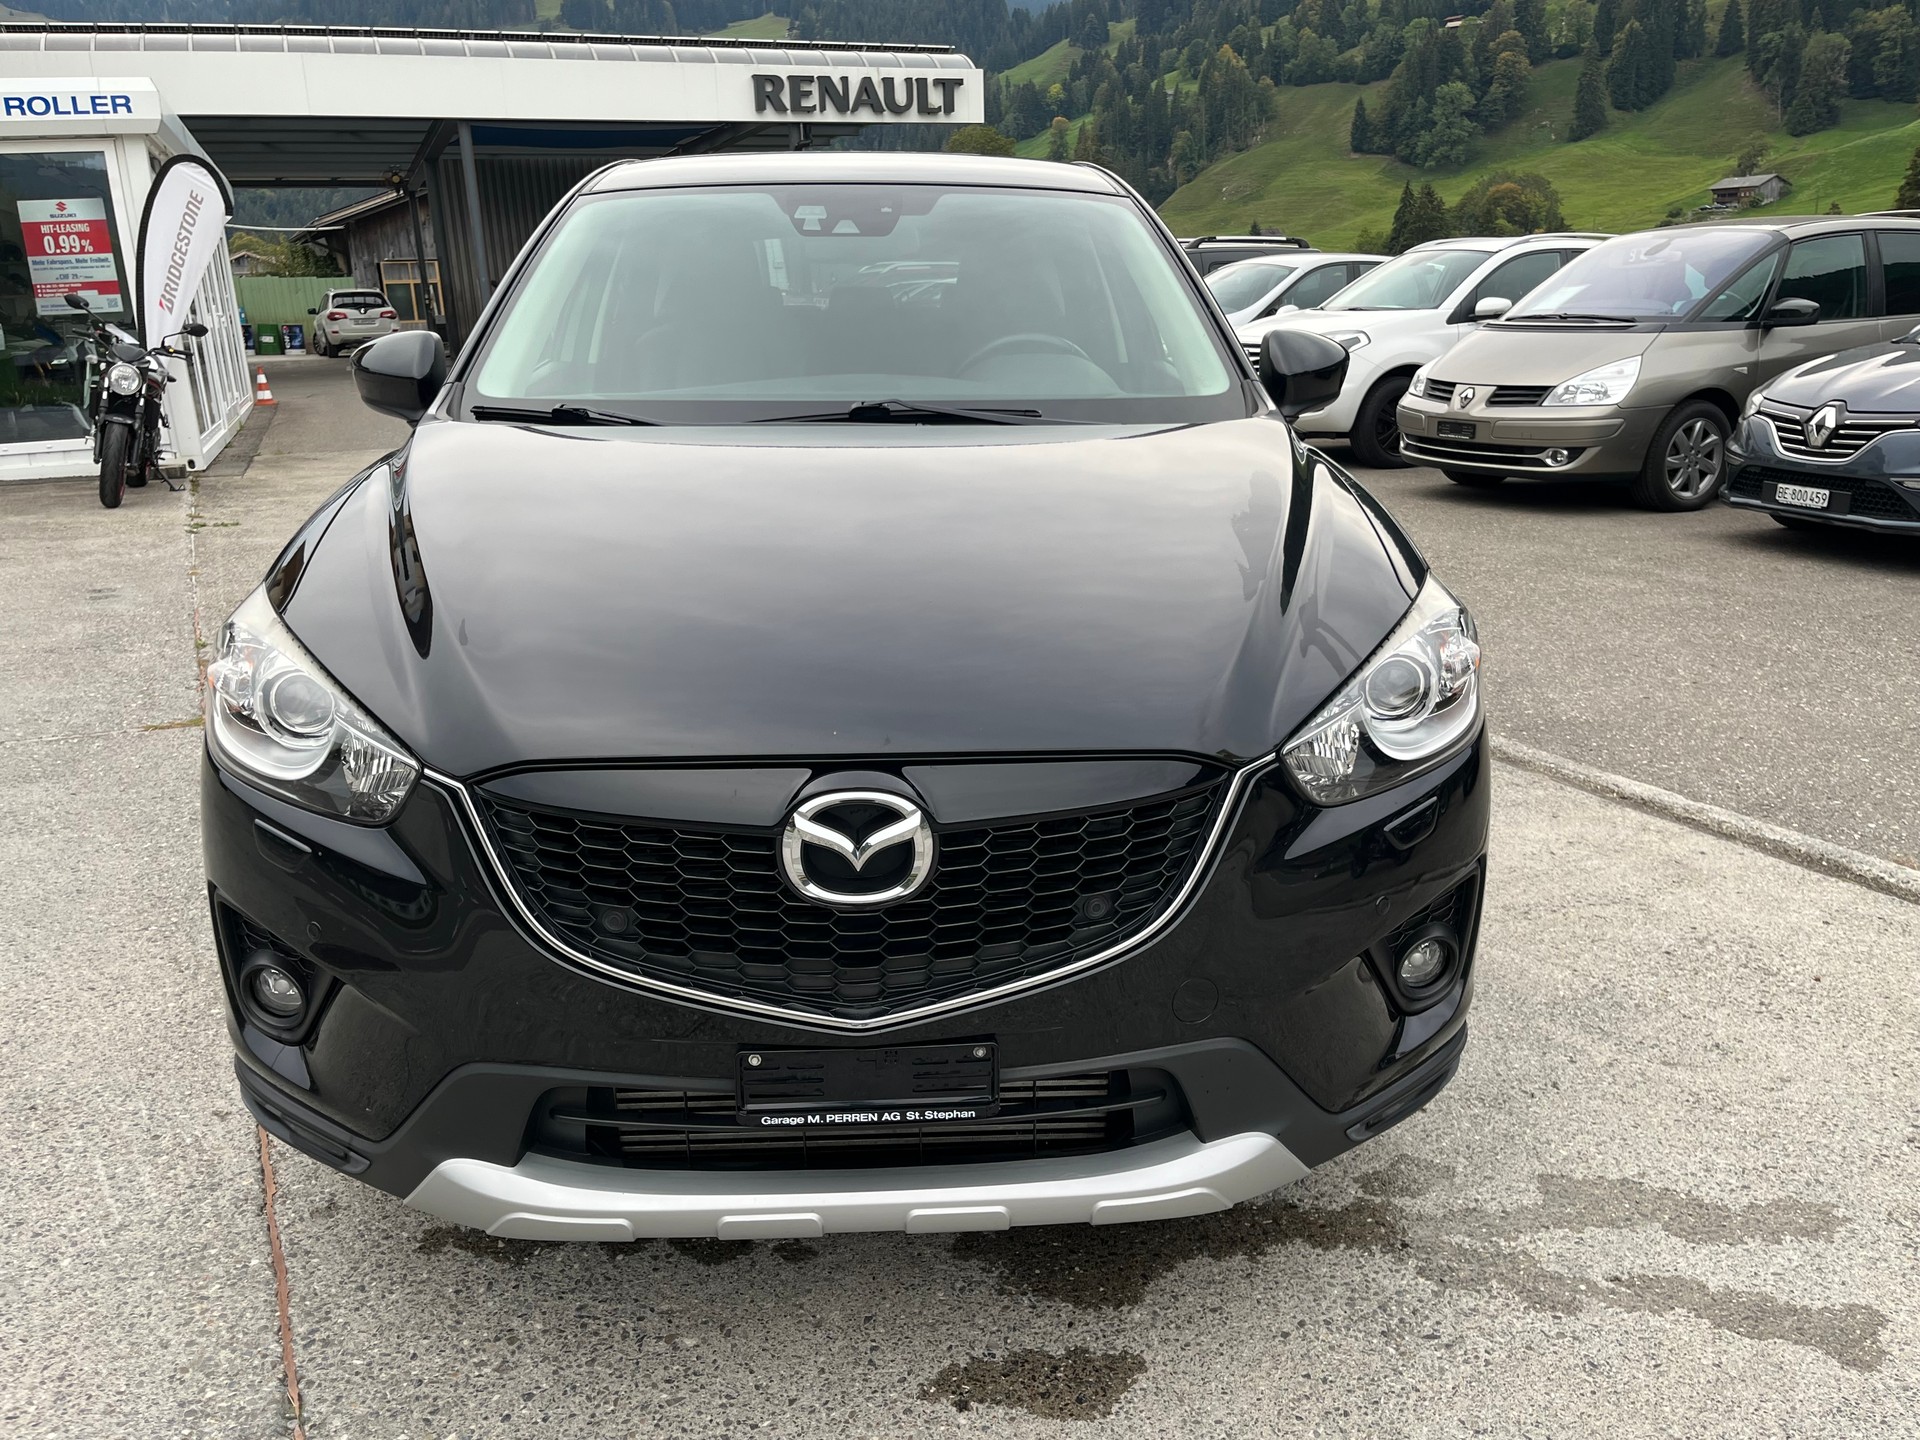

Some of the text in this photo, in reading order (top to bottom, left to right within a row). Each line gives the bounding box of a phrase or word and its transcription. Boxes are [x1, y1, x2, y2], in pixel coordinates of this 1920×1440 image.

[751, 74, 964, 115] RENAULT
[3, 95, 133, 116] ROLLER
[40, 223, 90, 234] HIT-LEASING
[159, 190, 204, 315] BRIDGESTONE
[761, 1116, 804, 1125] Garage
[807, 1115, 824, 1124] M.
[826, 1113, 878, 1123] PERREN
[881, 1112, 901, 1121] AG
